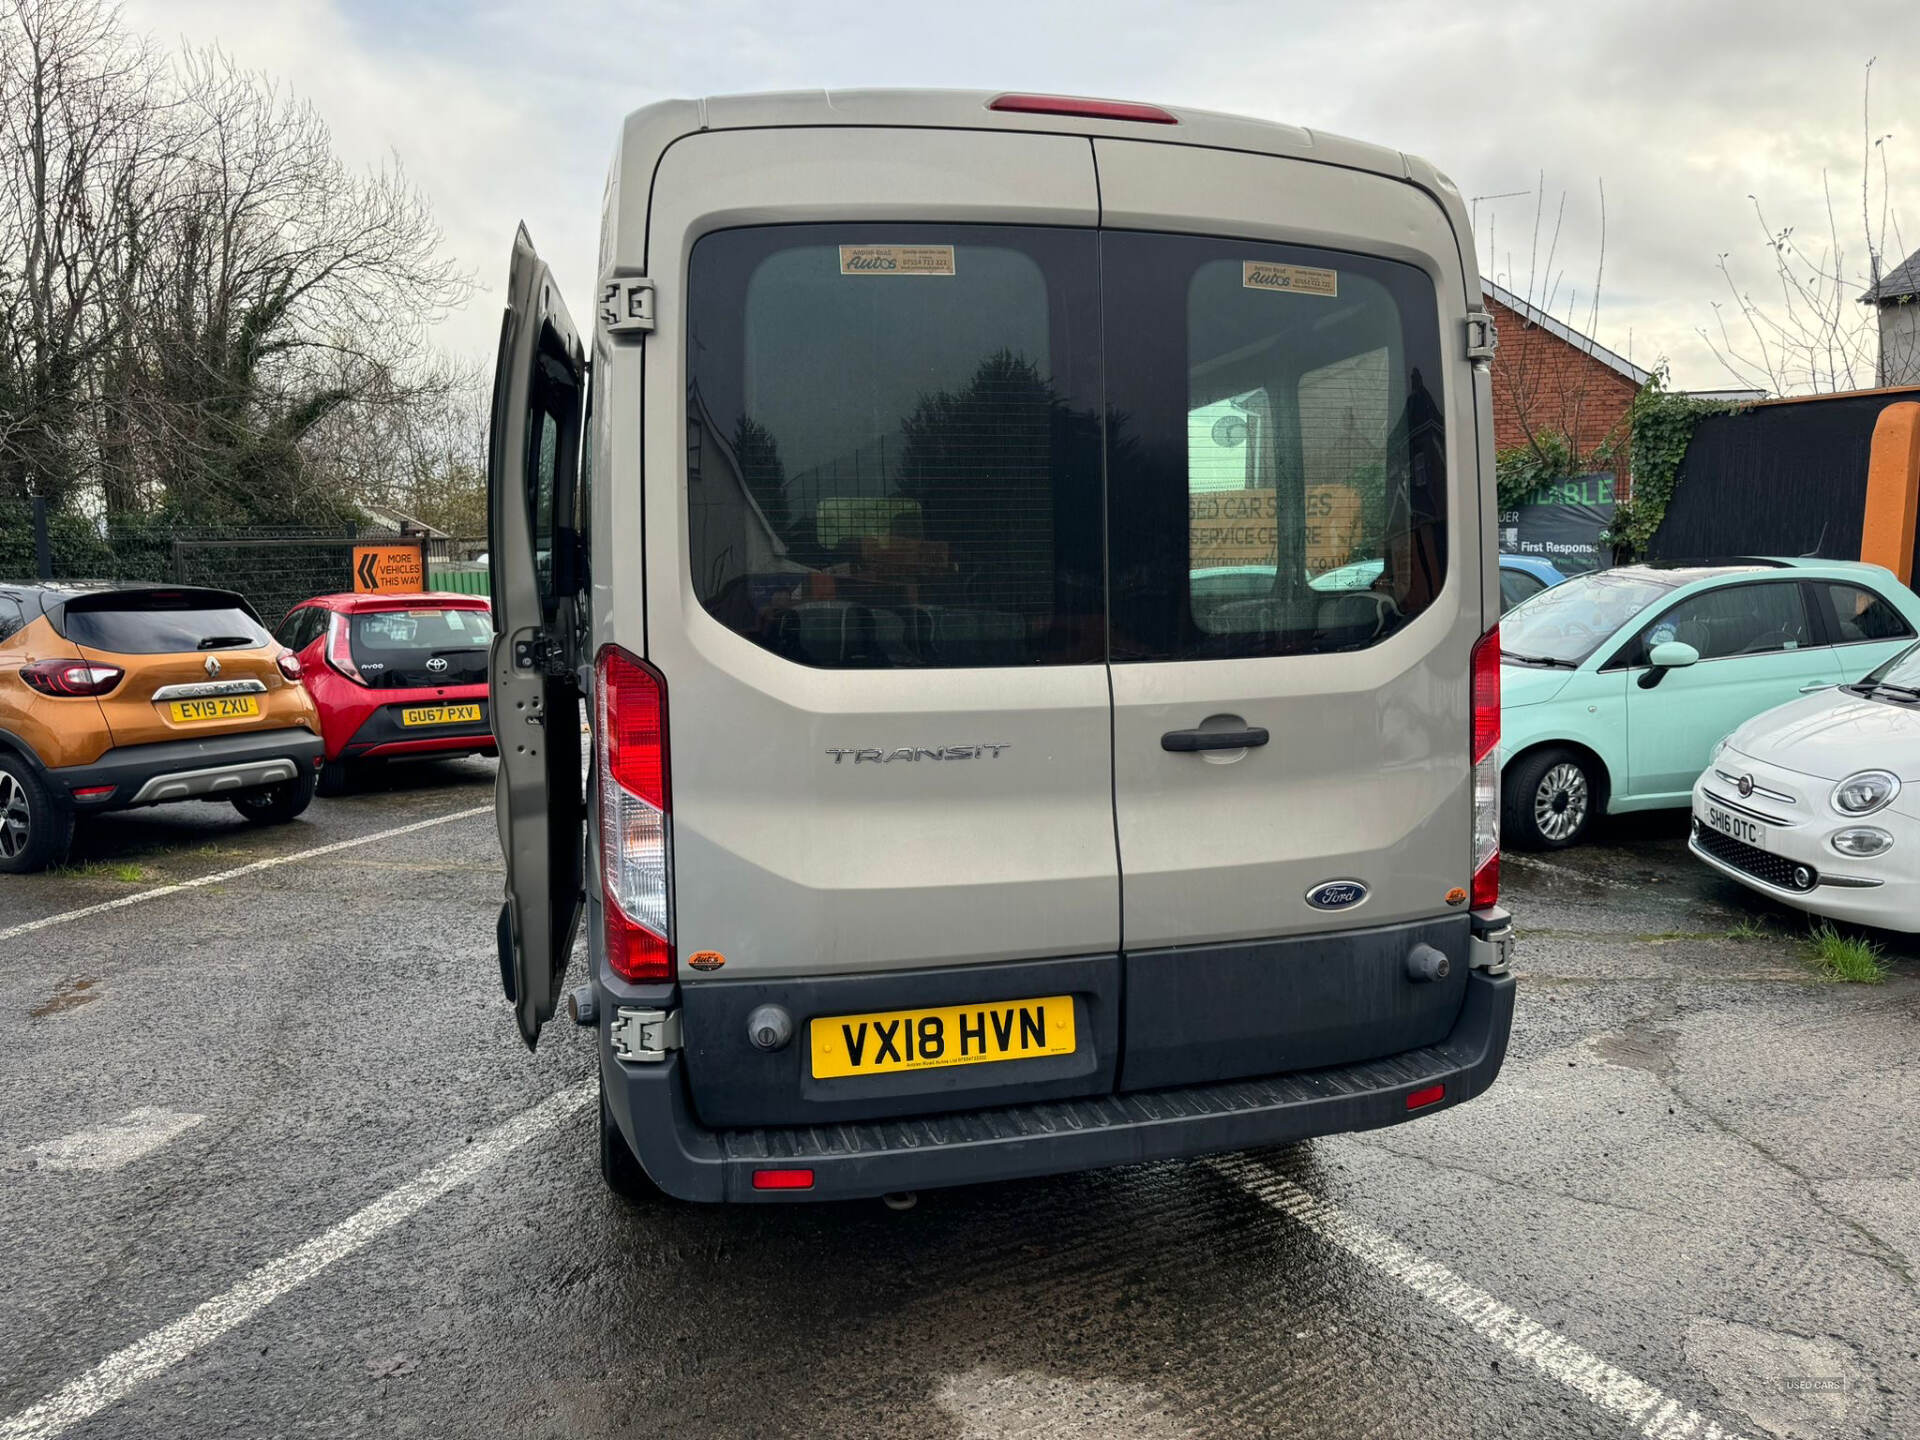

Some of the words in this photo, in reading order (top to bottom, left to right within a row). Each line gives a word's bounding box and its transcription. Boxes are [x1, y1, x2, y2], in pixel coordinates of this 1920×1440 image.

[847, 256, 897, 270] Autos
[1248, 271, 1290, 287] Autos
[1223, 497, 1261, 519] CAR
[1266, 493, 1333, 518] SES
[1499, 511, 1519, 523] DER
[1190, 526, 1253, 545] SERVICE
[1257, 526, 1322, 545] CERE
[1521, 541, 1544, 553] First
[387, 554, 412, 564] MORE
[380, 565, 420, 575] VEHICLES
[381, 577, 400, 586] THIS
[400, 576, 420, 585] WAY
[180, 701, 217, 718] EY19
[218, 698, 250, 715] ZXU
[408, 709, 445, 722] GU67
[447, 707, 473, 720] PXV
[825, 744, 1011, 764] TRANSIT
[1709, 808, 1732, 832] SH16
[1733, 818, 1758, 844] OTC
[1321, 886, 1355, 904] Ford
[842, 1016, 945, 1066] VX18
[958, 1005, 1046, 1056] HVN
